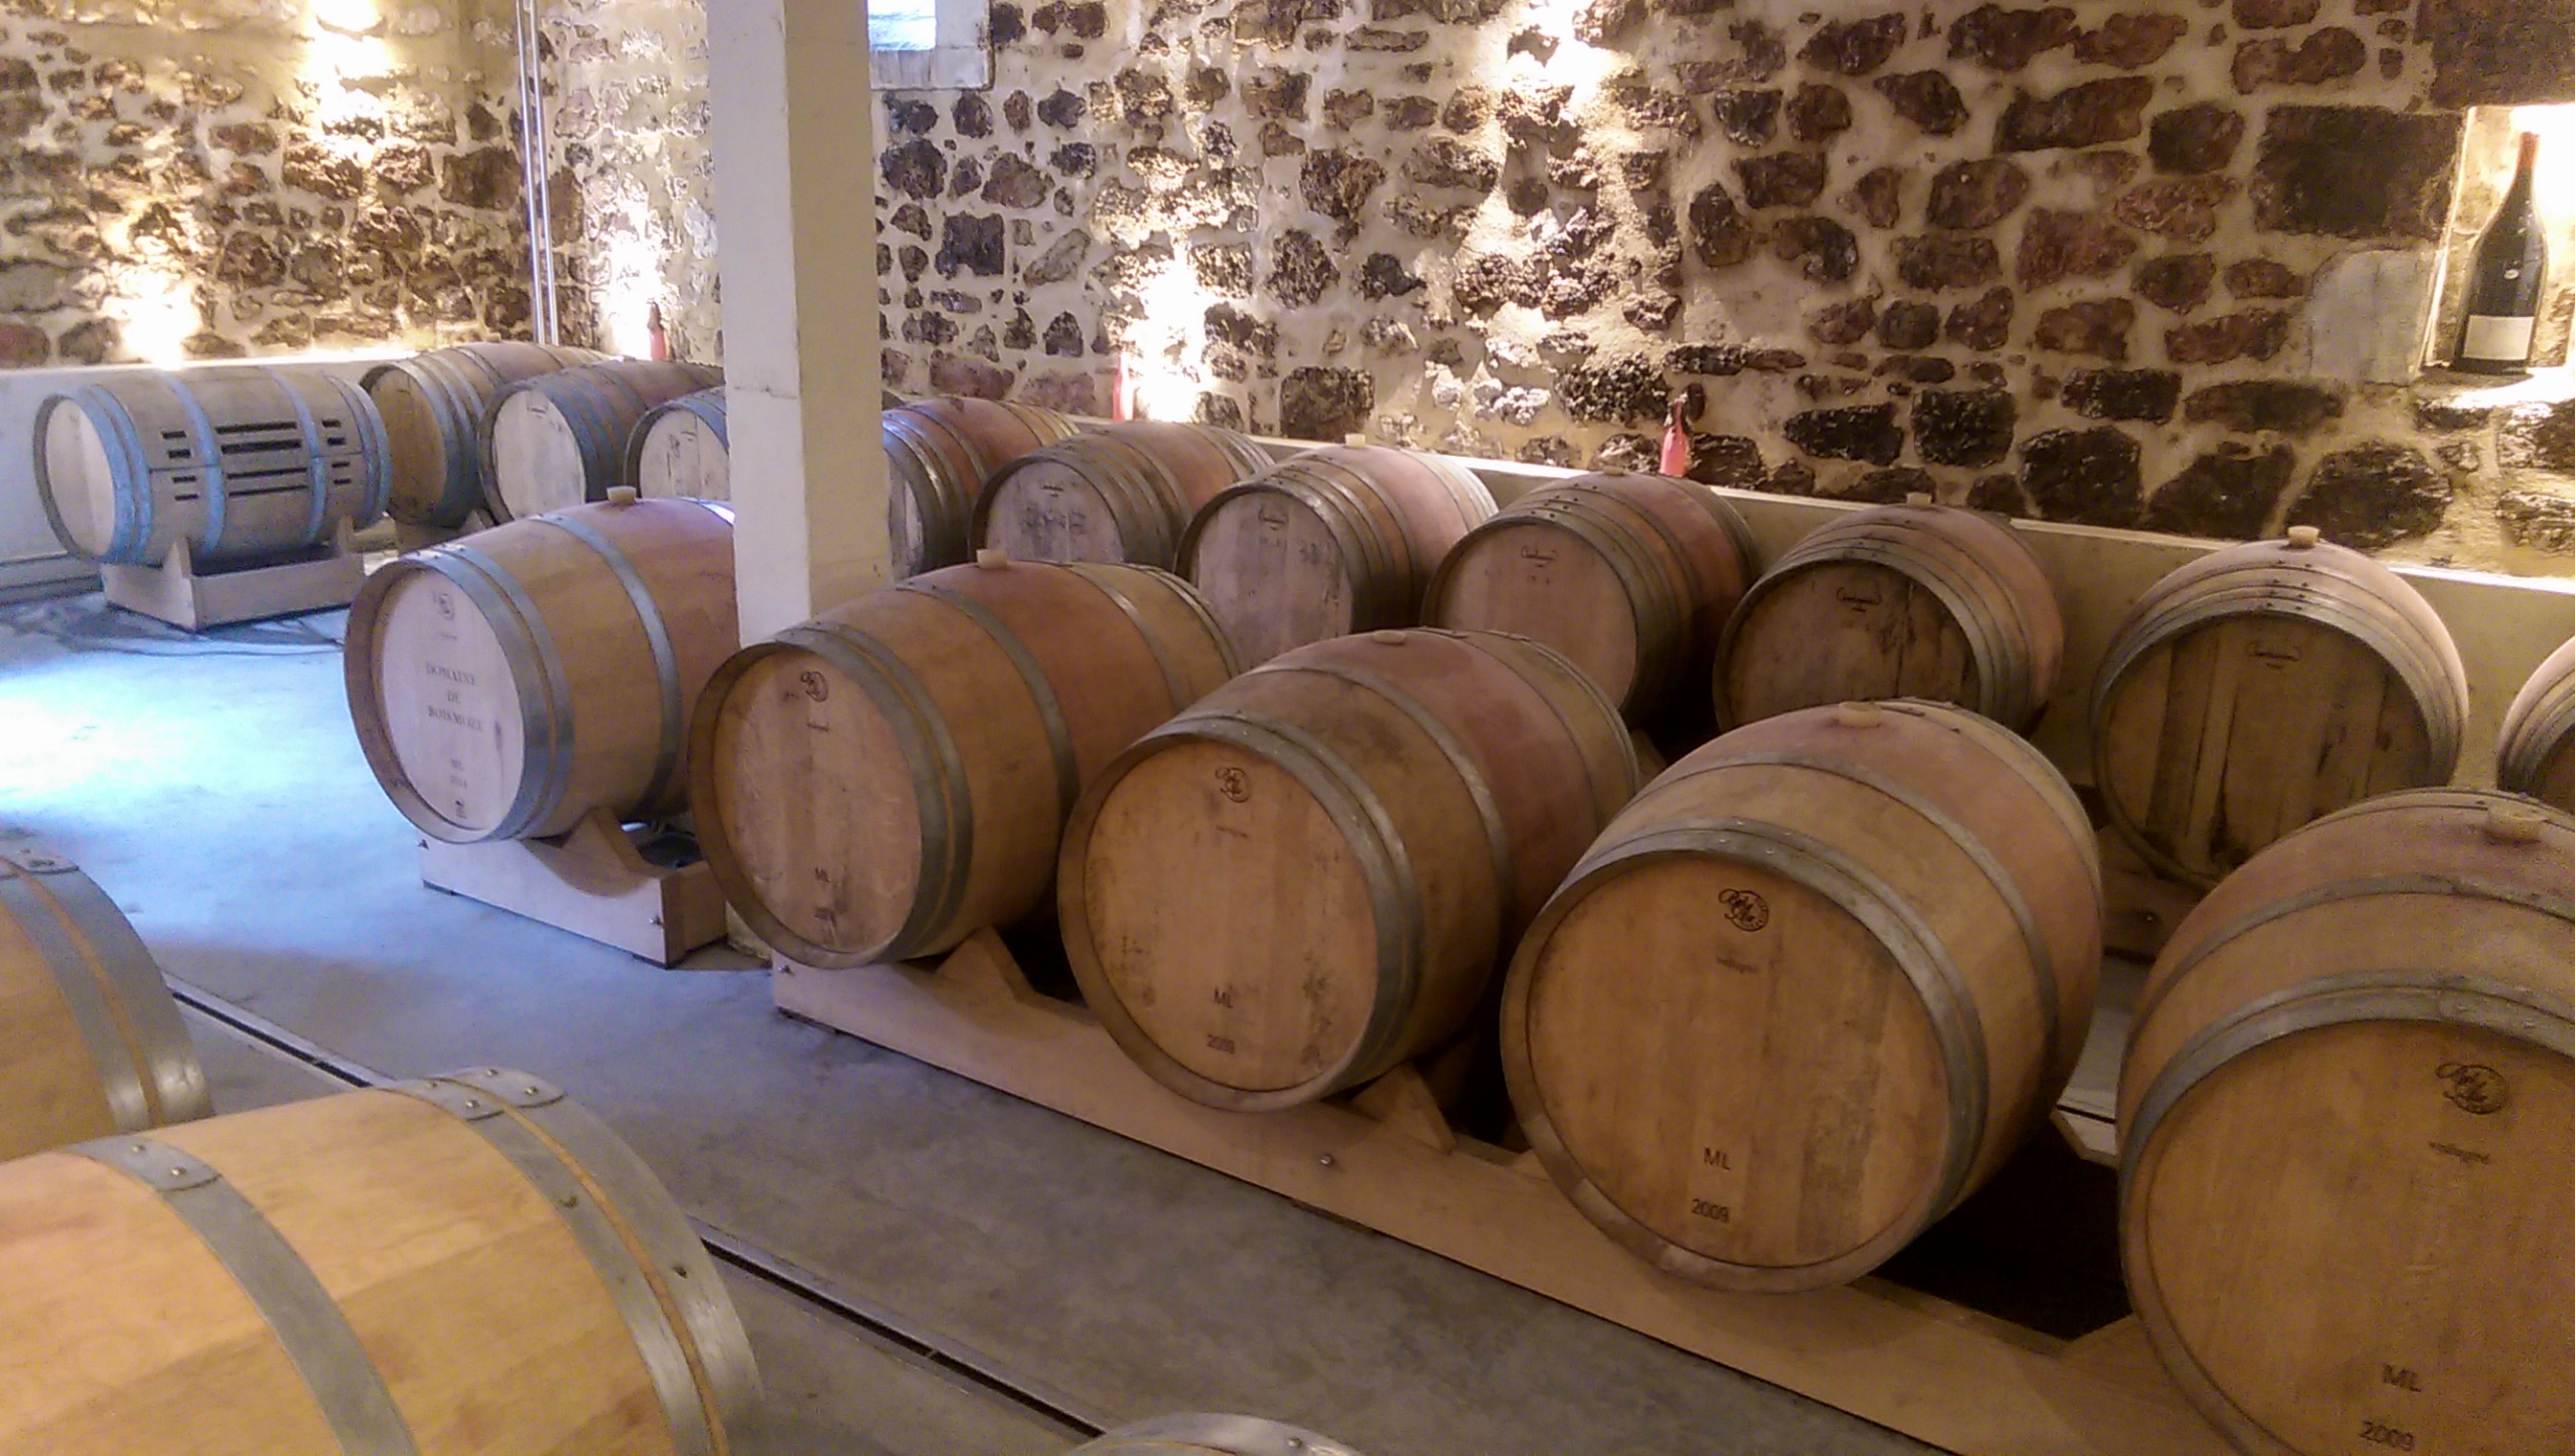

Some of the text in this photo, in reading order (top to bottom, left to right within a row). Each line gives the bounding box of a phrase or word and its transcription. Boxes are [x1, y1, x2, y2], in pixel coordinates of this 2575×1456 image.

[1214, 987, 1233, 1009] ML
[1704, 1148, 1731, 1171] ML
[1692, 1198, 1729, 1222] 2009
[2382, 1364, 2422, 1393] ML
[2359, 1420, 2415, 1452] 2009
